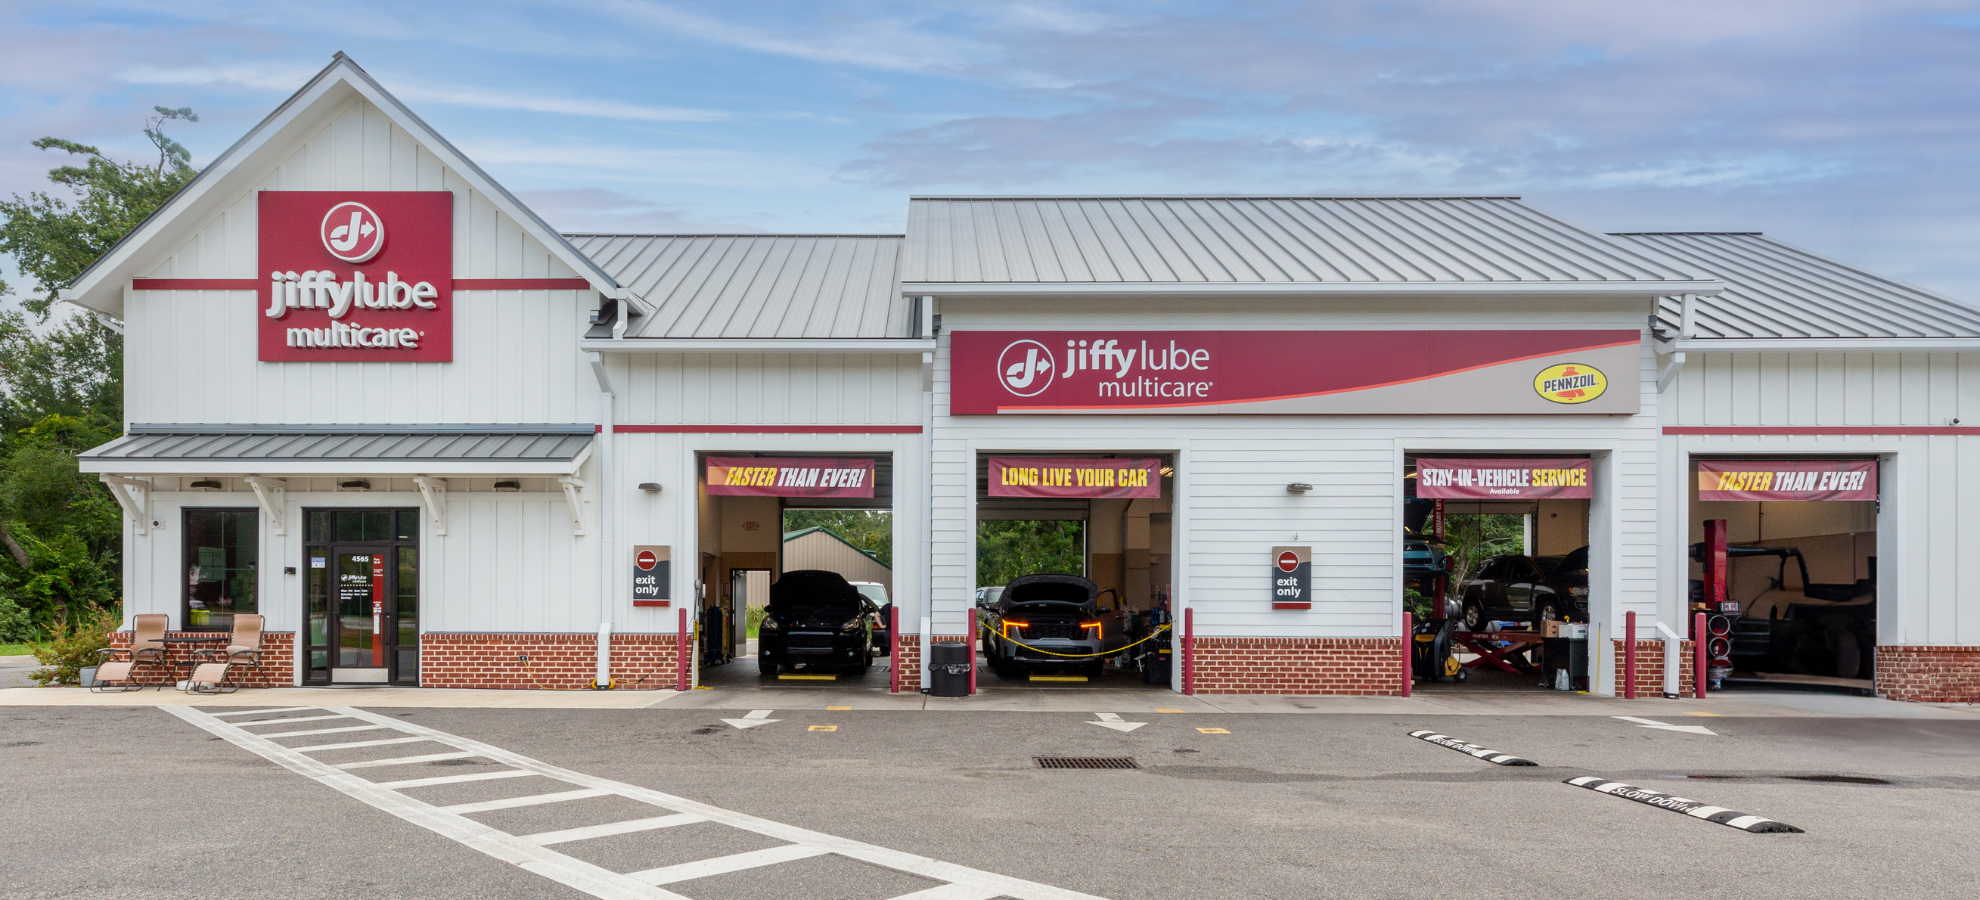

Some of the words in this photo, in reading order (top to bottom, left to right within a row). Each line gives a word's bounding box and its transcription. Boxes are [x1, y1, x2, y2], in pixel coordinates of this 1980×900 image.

[1543, 373, 1597, 393] PENNZOIL
[724, 467, 778, 487] FASTER
[777, 467, 821, 487] THAN
[819, 468, 867, 488] EVER!
[1002, 467, 1039, 486] LONG
[1042, 468, 1072, 487] LIVE
[1076, 468, 1115, 487] YOUR
[1118, 468, 1148, 487] CAR
[1422, 468, 1530, 487] STAY-IN-VEHICLE
[1532, 468, 1587, 487] SERVICE
[1717, 471, 1774, 491] FASTER
[1773, 471, 1818, 491] THAN
[1818, 471, 1867, 491] EVER!
[1489, 487, 1520, 495] Available
[635, 575, 656, 585] exit
[1276, 576, 1298, 586] exit
[635, 584, 659, 596] only
[1276, 586, 1302, 598] only
[1611, 787, 1654, 801] SLOW
[1648, 796, 1699, 813] DOWN
